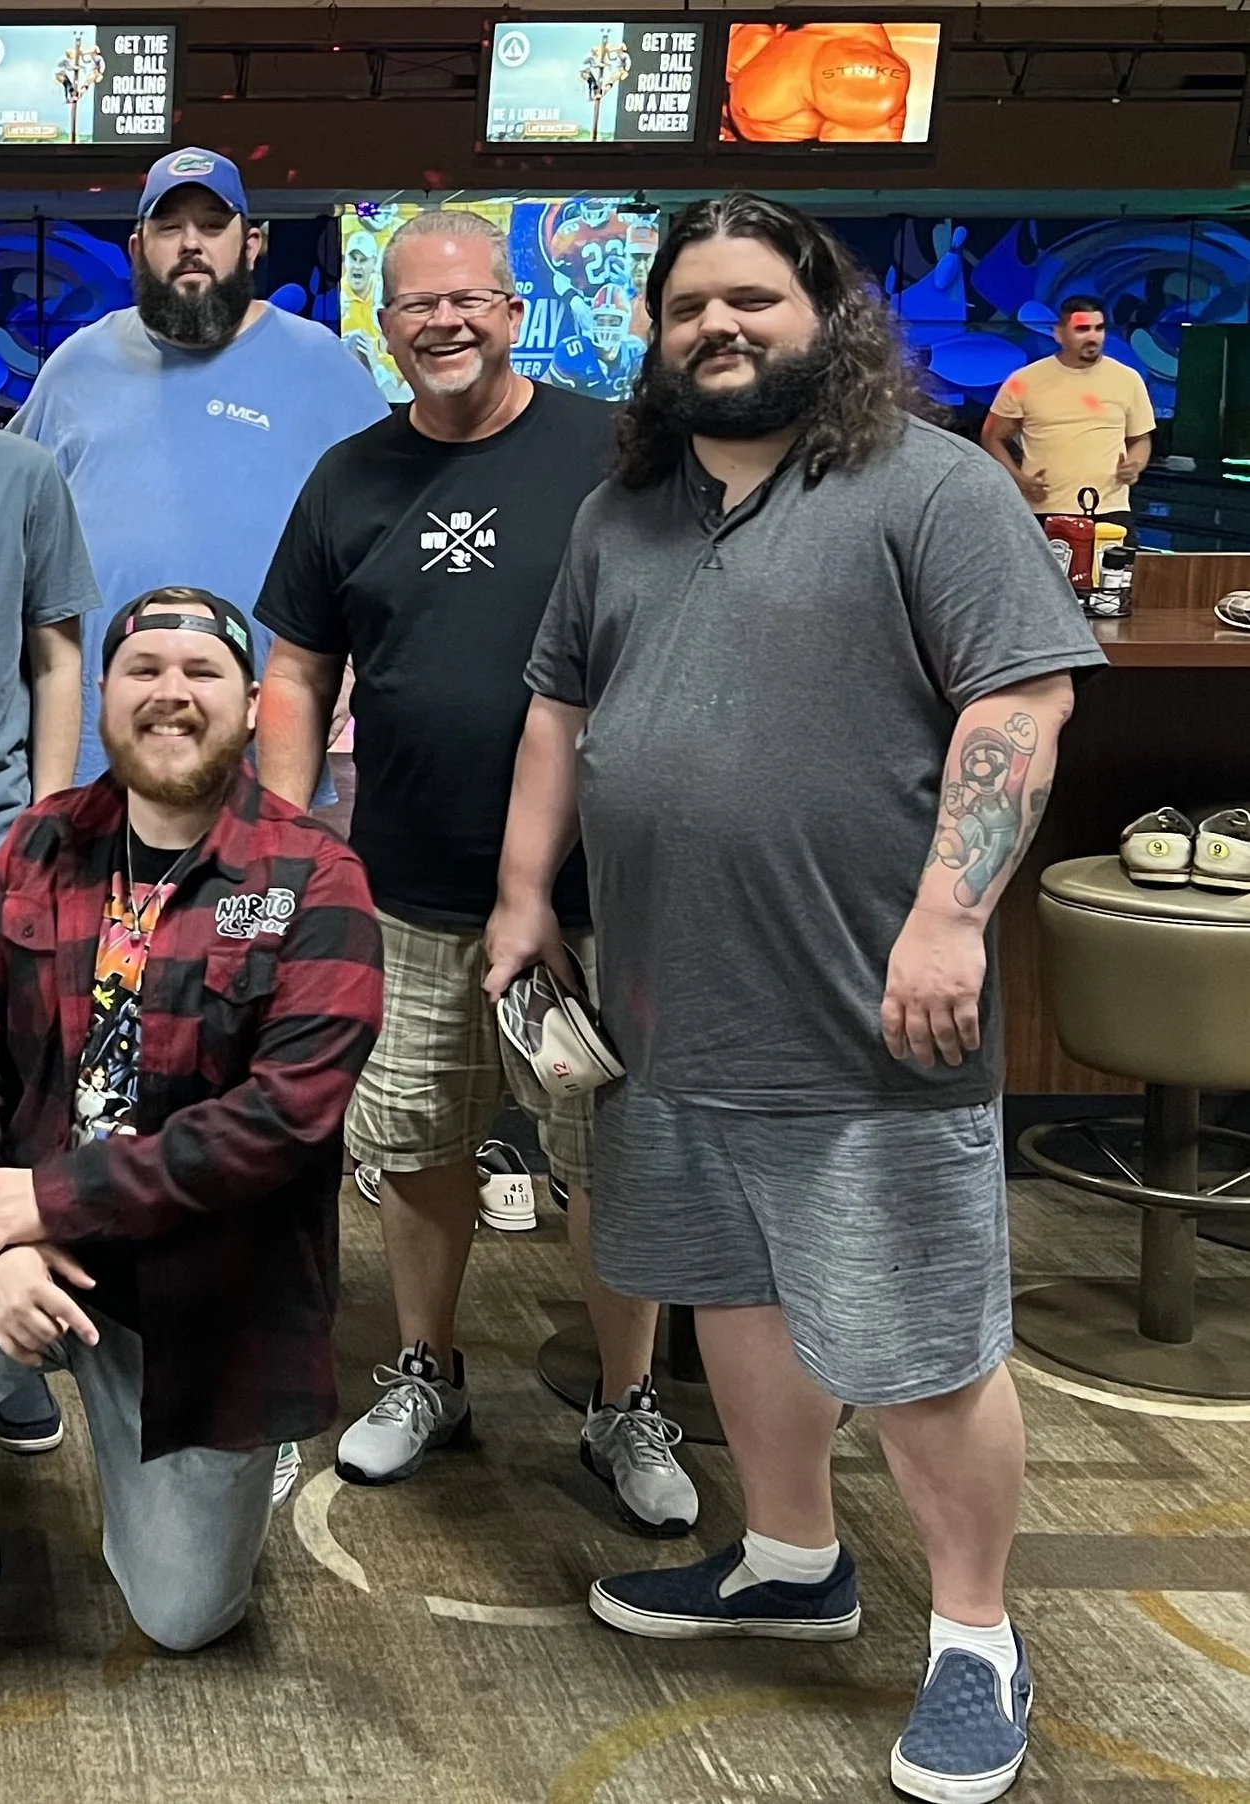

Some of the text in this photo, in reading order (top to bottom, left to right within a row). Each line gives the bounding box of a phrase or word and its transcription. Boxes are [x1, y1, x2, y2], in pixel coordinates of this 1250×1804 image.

[114, 35, 168, 54] GET THE
[642, 33, 696, 52] GET THE
[134, 55, 167, 74] BALL
[660, 53, 693, 72] BALL
[822, 66, 906, 79] STRIKE
[112, 76, 166, 94] ROLLING
[638, 73, 692, 92] ROLLING
[102, 95, 166, 114] ON A NEW
[625, 93, 690, 112] ON A NEW
[116, 116, 165, 134] CAREER
[638, 114, 688, 132] CAREER
[1214, 844, 1222, 854] 9
[510, 1184, 524, 1192] 45
